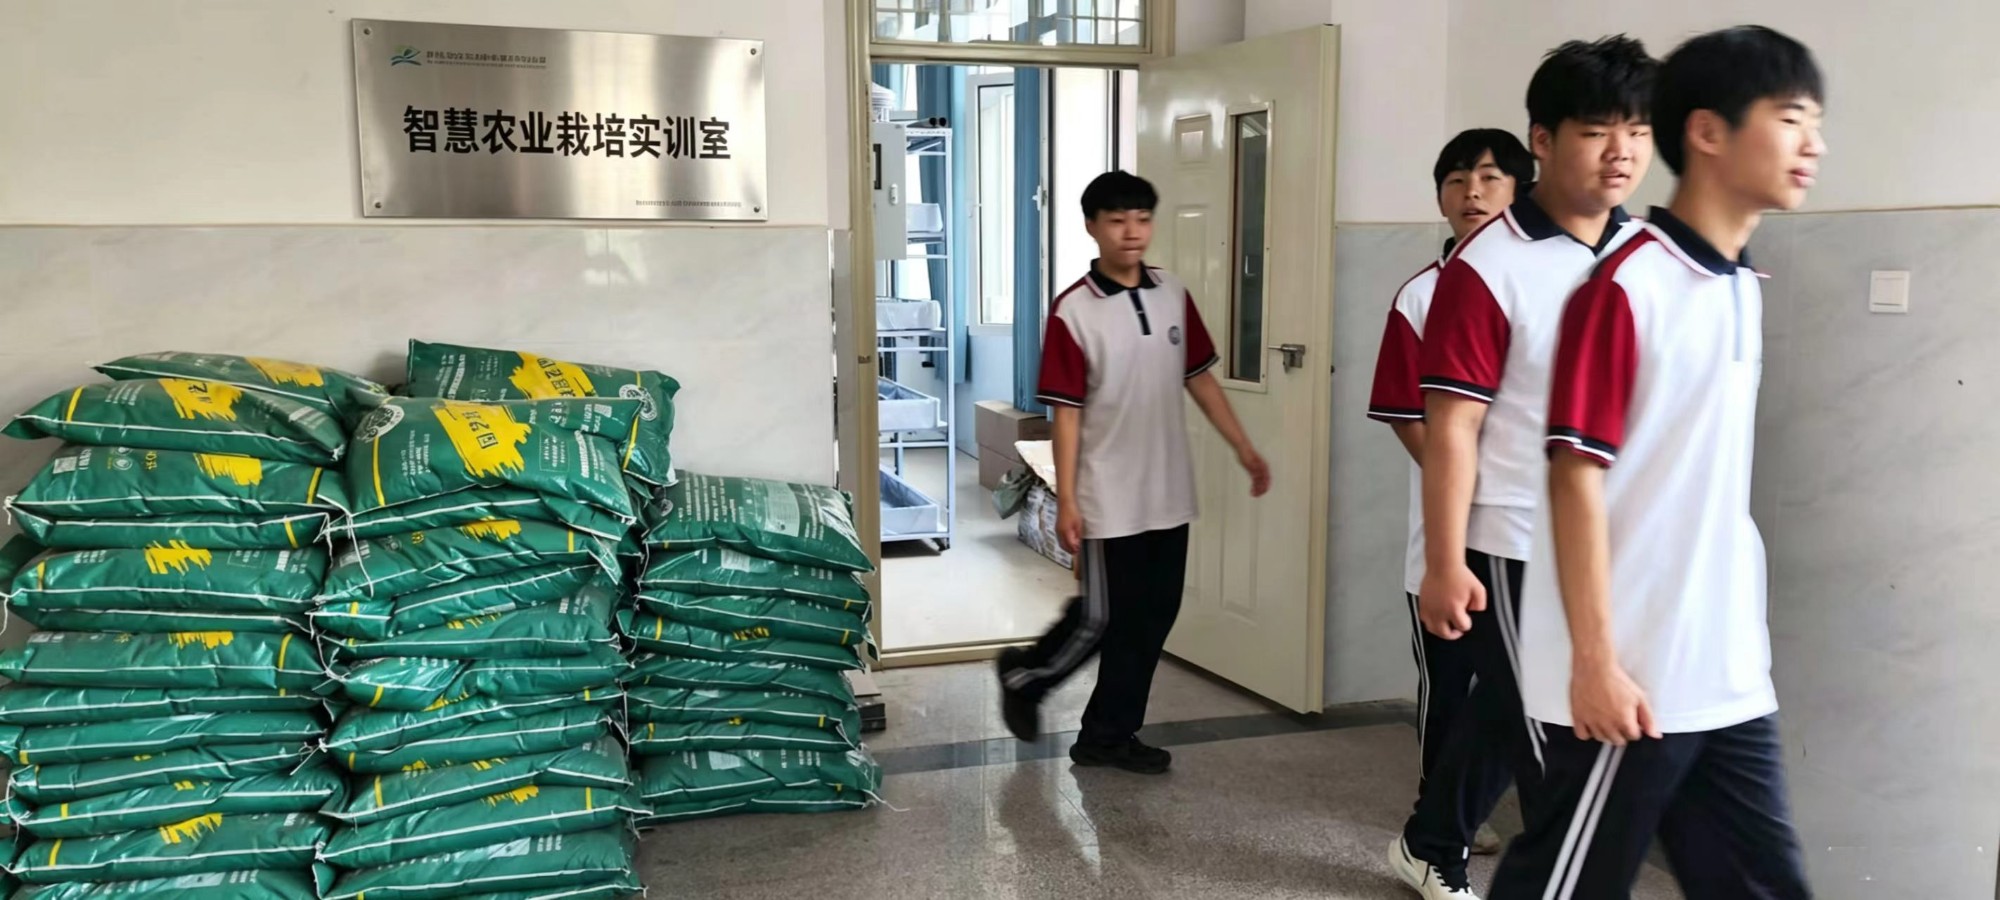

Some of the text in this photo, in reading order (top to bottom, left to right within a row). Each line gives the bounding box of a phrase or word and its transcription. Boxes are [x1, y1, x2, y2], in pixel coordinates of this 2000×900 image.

[403, 105, 731, 160] 智慧农业栽培实训室
